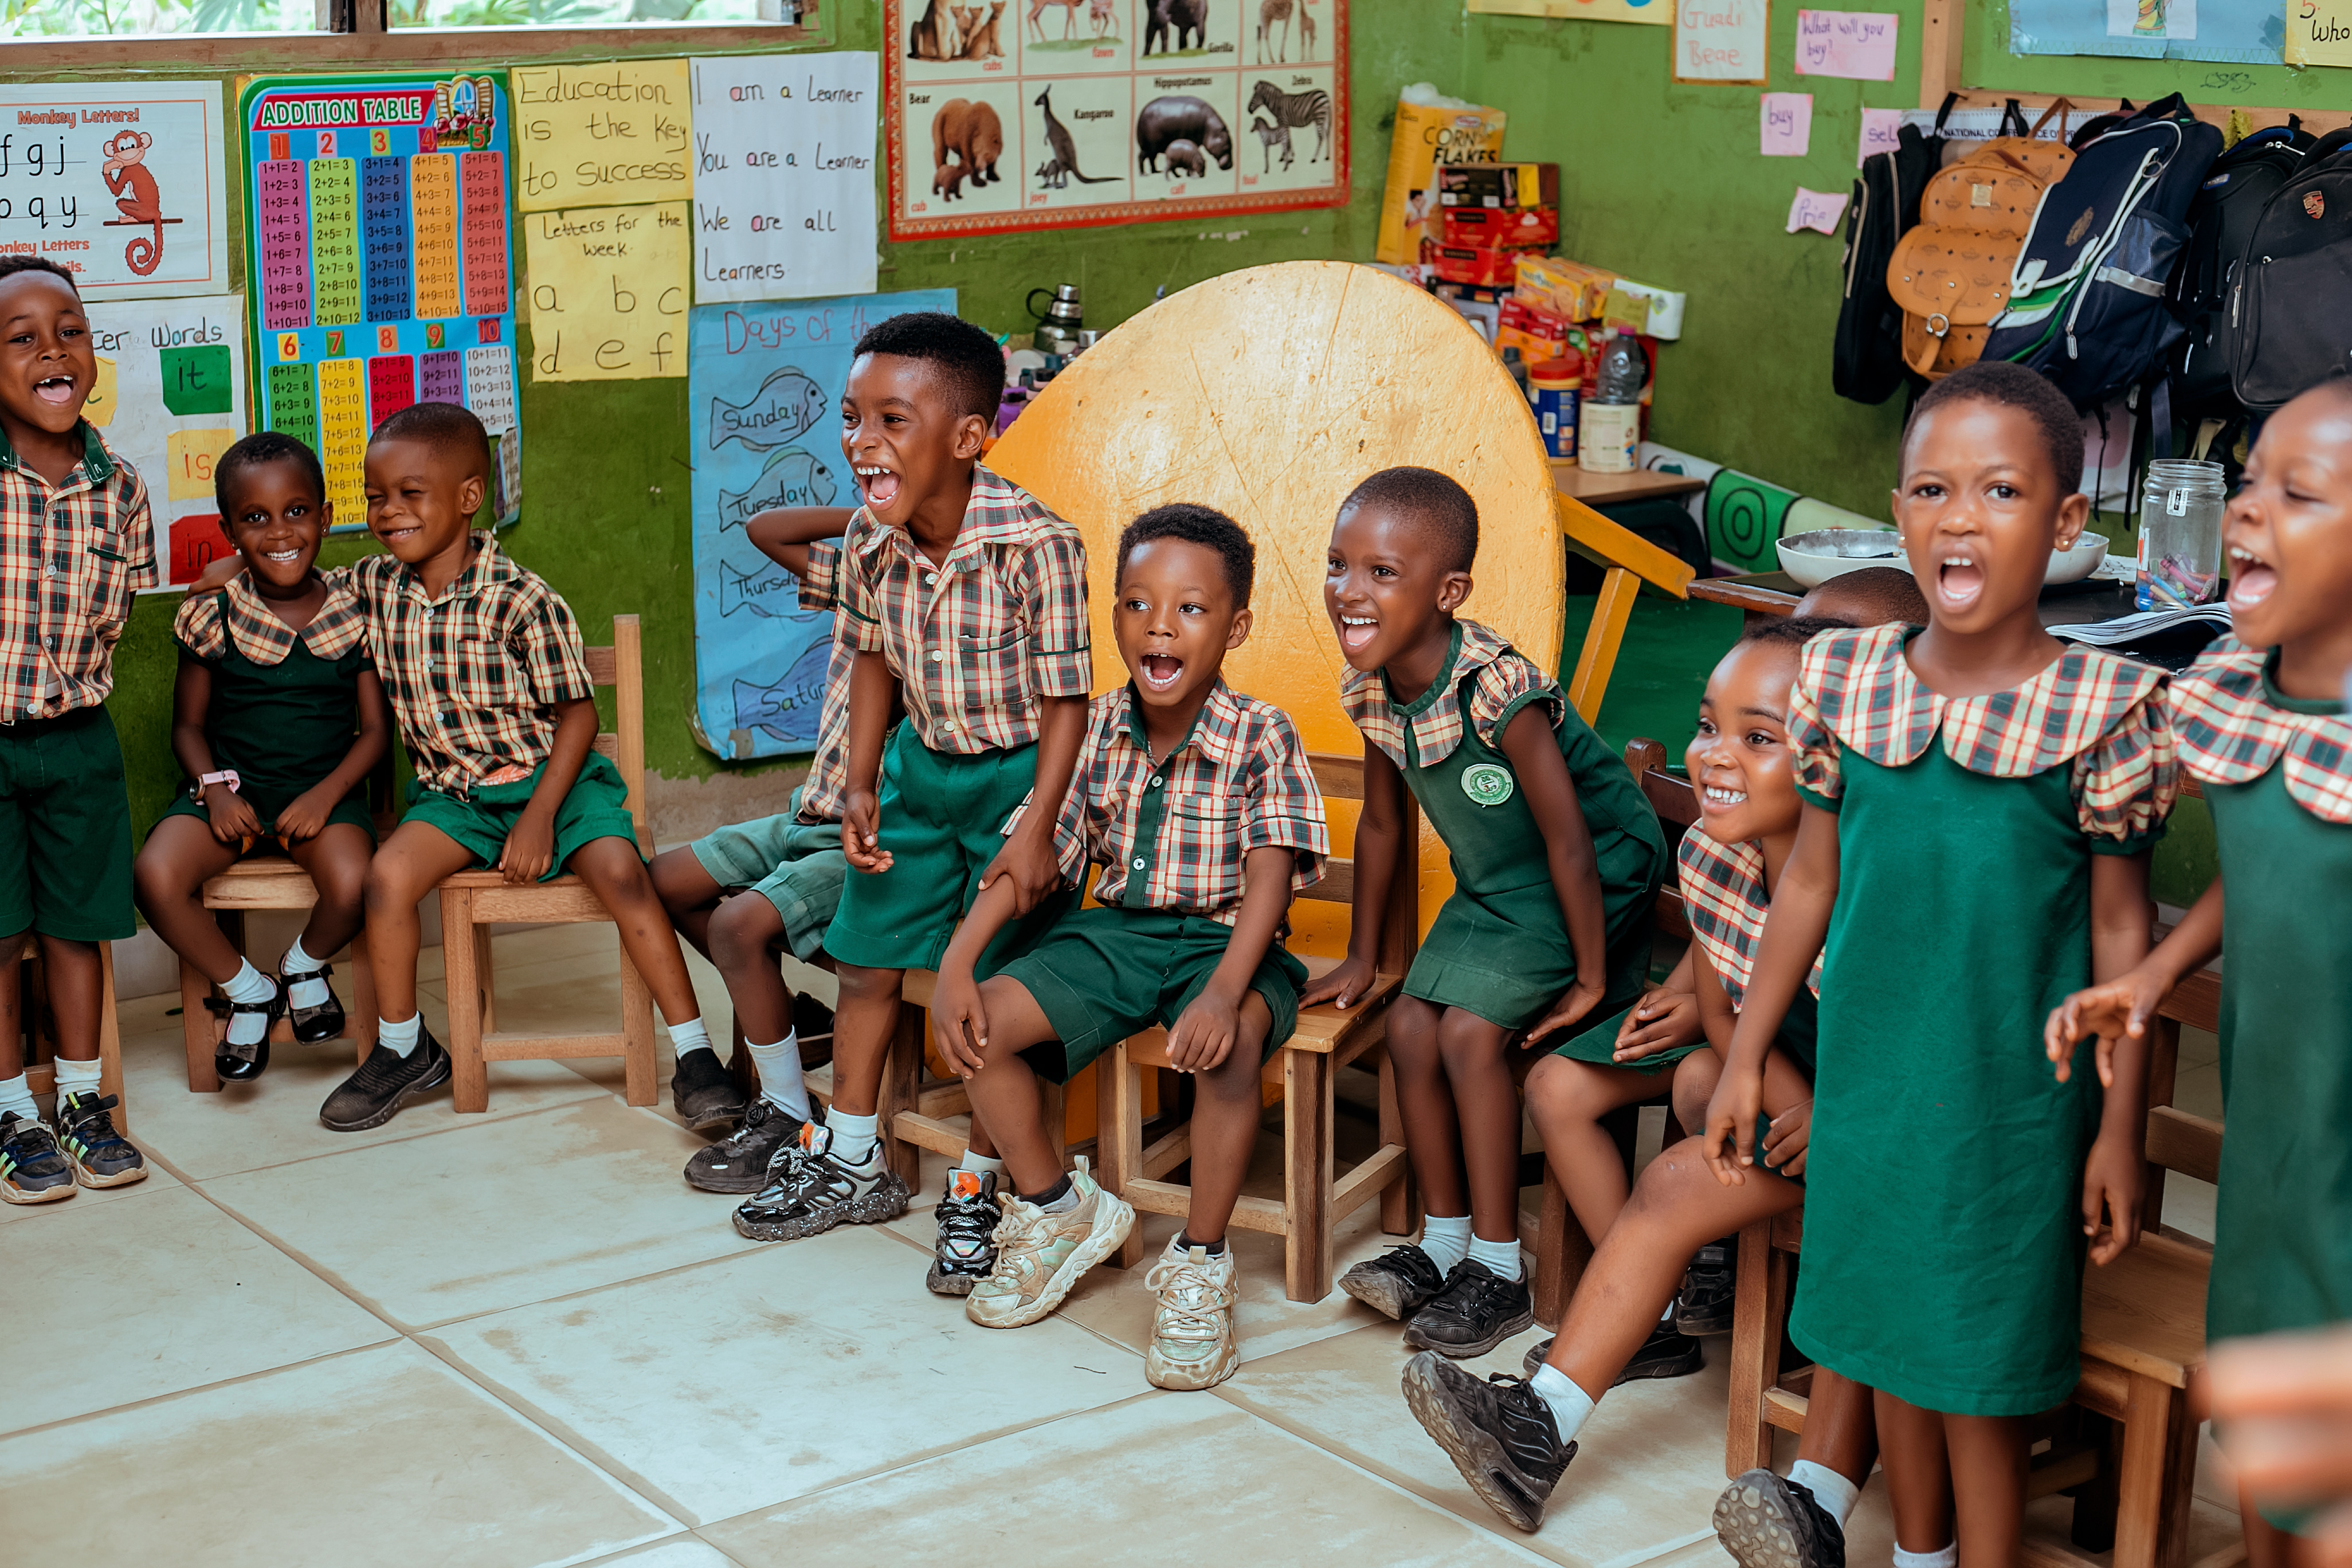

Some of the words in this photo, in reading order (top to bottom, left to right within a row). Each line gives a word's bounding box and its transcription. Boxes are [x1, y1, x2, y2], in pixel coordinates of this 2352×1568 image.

[1803, 13, 1830, 36] What
[1839, 17, 1858, 34] will
[1859, 23, 1884, 42] you
[2312, 17, 2350, 42] Who
[519, 69, 672, 104] Education
[696, 65, 701, 105] I
[730, 84, 764, 101] am
[781, 86, 793, 97] a
[807, 75, 863, 103] Learner
[910, 93, 931, 104] Bear
[18, 109, 76, 128] Monkey
[82, 108, 139, 123] Letters!
[262, 100, 357, 126] ADDITION
[364, 97, 421, 122] TABLE
[1769, 100, 1793, 136] buy
[524, 114, 551, 140] is
[585, 112, 637, 139] the
[1424, 126, 1475, 146] CORN
[1868, 124, 1897, 143] sel
[1944, 128, 1986, 137] NATIONAL
[28, 144, 42, 176] g
[54, 136, 64, 175] j
[273, 135, 283, 156] 1
[320, 134, 332, 153] 2
[373, 131, 387, 153] 3
[421, 128, 434, 150] 4
[472, 128, 485, 148] 5
[696, 132, 729, 177] You
[747, 151, 779, 167] are
[786, 152, 798, 166] a
[816, 142, 870, 170] Learner
[523, 162, 557, 195] to
[29, 197, 48, 229] q
[61, 196, 76, 228] y
[467, 219, 503, 231] 5+5=10
[543, 216, 605, 239] Letters
[615, 214, 639, 233] for
[657, 211, 683, 226] the
[700, 203, 730, 232] We
[751, 215, 783, 232] are
[805, 210, 836, 231] all
[0, 240, 36, 256] onkey
[42, 240, 89, 251] Letters
[417, 238, 453, 251] 4+6=10
[467, 236, 501, 248] 5+6=11
[370, 258, 406, 272] 3+7=10
[418, 256, 452, 268] 4+7=11
[468, 252, 504, 265] 5+7=12
[319, 279, 357, 292] 2+8=10
[370, 276, 405, 288] 3+8=11
[418, 272, 454, 285] 4+8=12
[469, 268, 505, 281] 5+8=13
[269, 299, 307, 312] 1+9=10
[320, 296, 355, 308] 2+9=11
[370, 292, 407, 305] 3+9=12
[419, 289, 455, 301] 4+9=13
[469, 285, 505, 297] 5+9=14
[534, 285, 565, 312] a
[613, 274, 635, 312] b
[658, 287, 682, 315] c
[268, 316, 308, 330] 1+10=11
[316, 312, 360, 326] 2+10=12
[367, 308, 410, 322] 3+10=13
[417, 305, 460, 318] 4+10=14
[467, 301, 508, 315] 5+10=15
[283, 335, 297, 356] 6
[328, 332, 342, 354] 7
[379, 329, 393, 348] 8
[428, 324, 441, 346] 9
[477, 321, 499, 340] 10
[724, 311, 795, 354] Days
[423, 351, 458, 365] 9+1=10
[468, 347, 508, 360] 10+1=11
[540, 330, 562, 374] d
[595, 340, 630, 369] e
[650, 332, 672, 372] f
[178, 358, 207, 391] it
[373, 373, 410, 386] 8+2=10
[423, 369, 457, 382] 9+2=11
[469, 364, 510, 377] 10+2=12
[323, 393, 359, 407] 7+3=10
[373, 389, 409, 403] 8+3=11
[424, 385, 459, 398] 9+3=12
[469, 380, 511, 394] 10+3=13
[275, 414, 313, 428] 6+4=10
[325, 411, 358, 424] 7+4=11
[471, 397, 512, 410] 10+4=14
[722, 399, 799, 432] Sunday
[324, 427, 360, 441] 7+5=12
[184, 445, 212, 480] is
[326, 444, 362, 457] 7+6=13
[326, 461, 362, 475] 7+7=14
[187, 534, 212, 568] in
[761, 683, 825, 717] Satur
